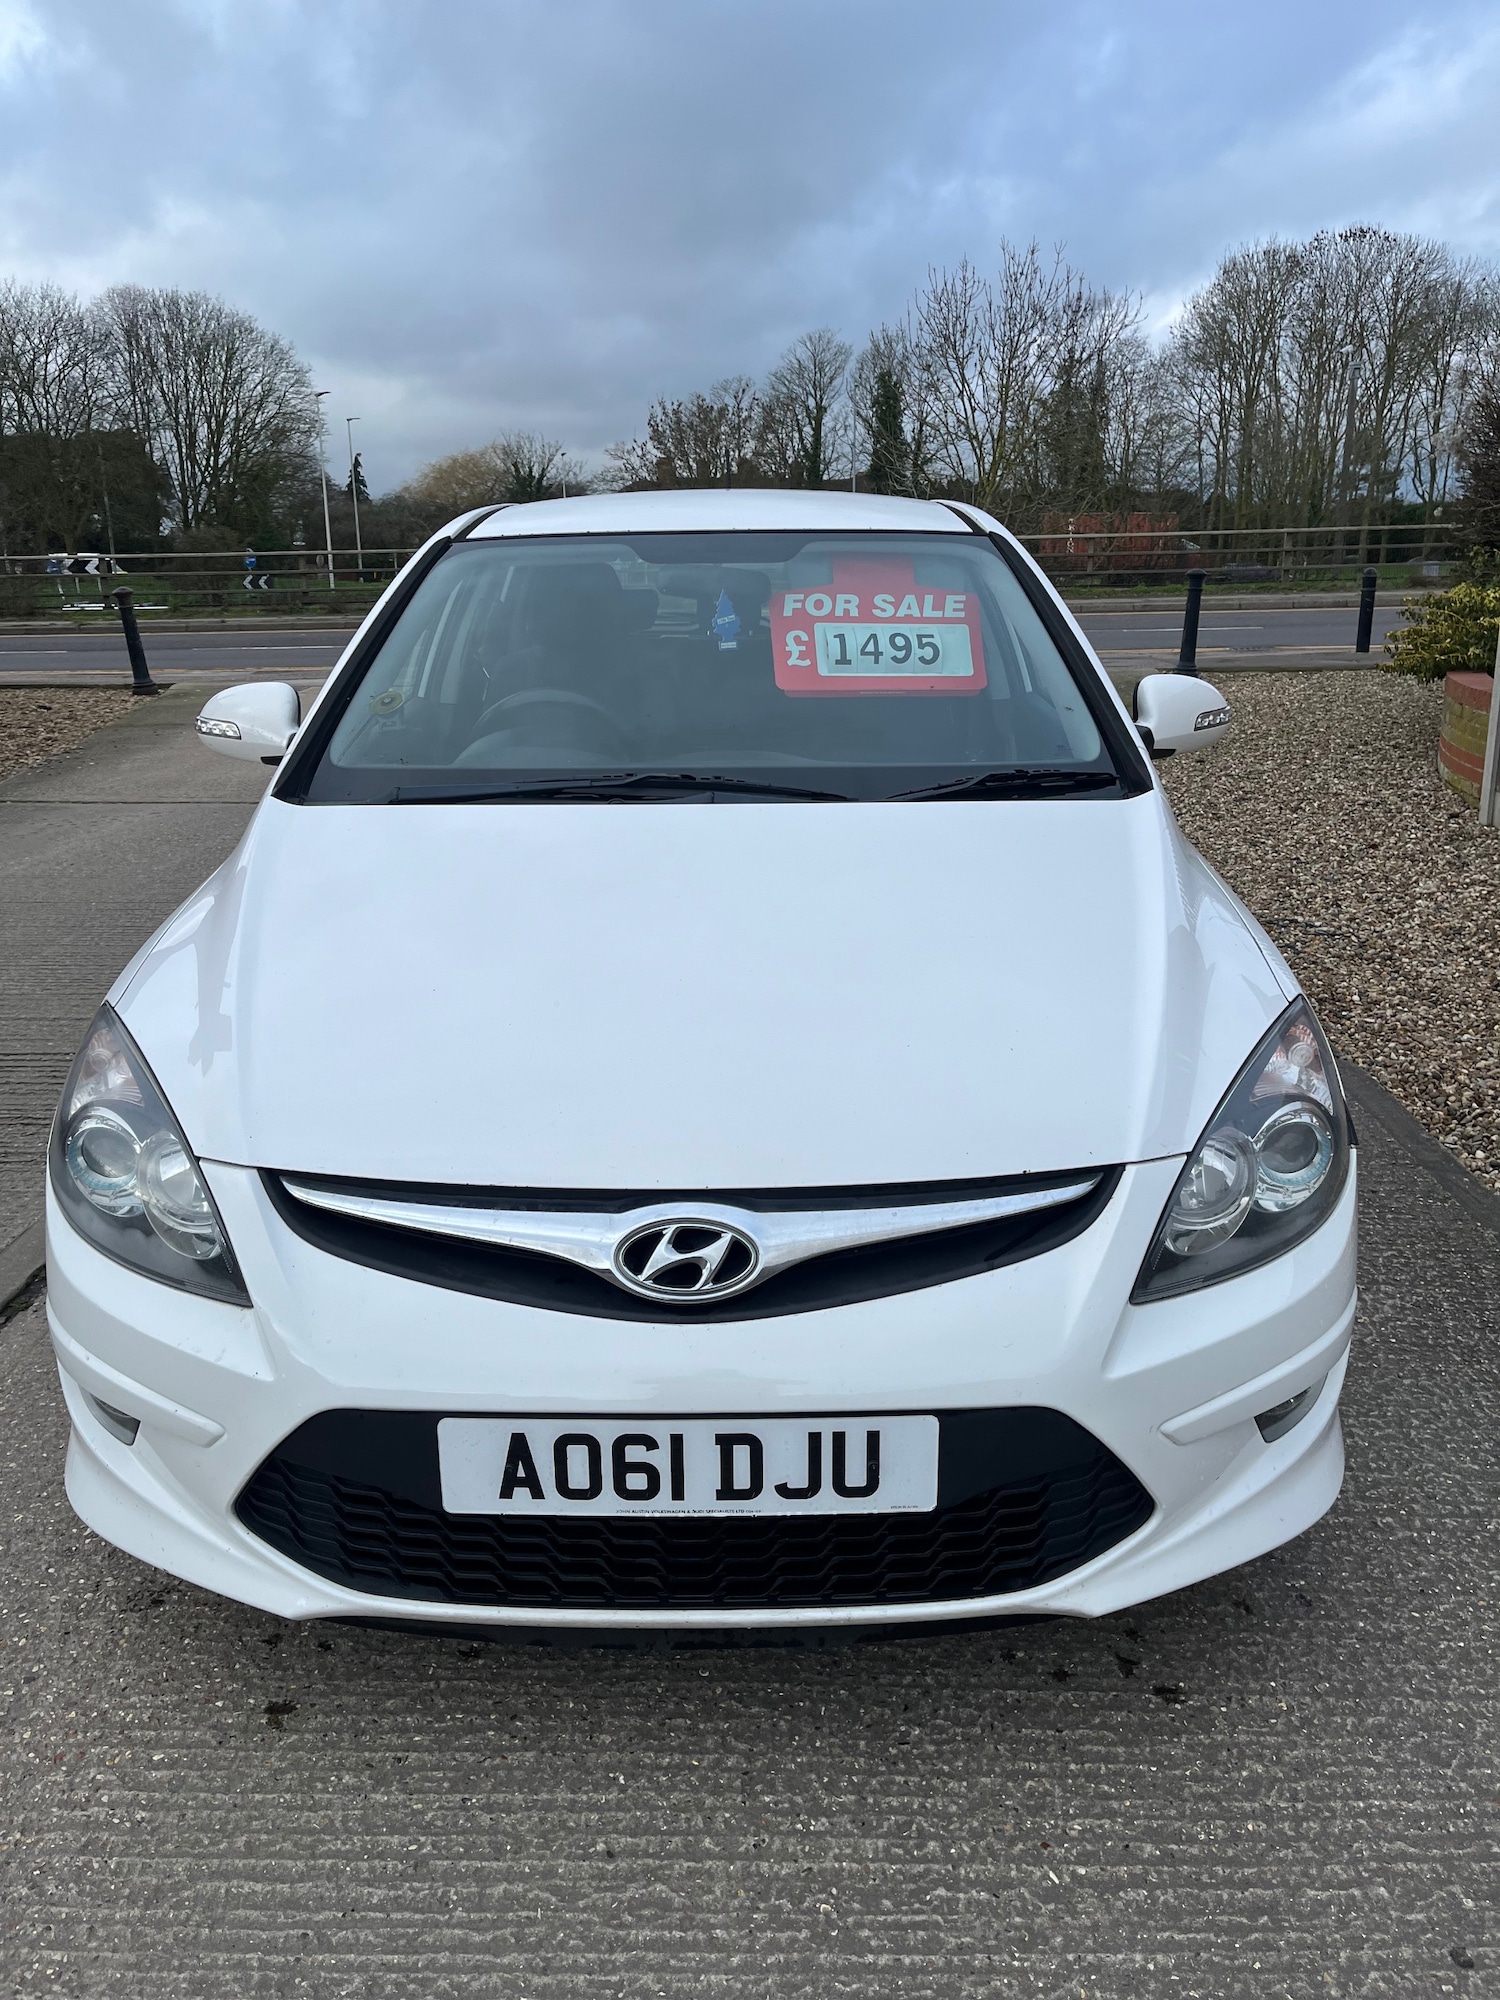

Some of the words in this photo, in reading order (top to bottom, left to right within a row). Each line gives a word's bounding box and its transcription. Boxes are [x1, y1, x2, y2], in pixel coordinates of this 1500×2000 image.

[783, 593, 860, 617] FOR
[871, 593, 967, 618] SALE
[785, 630, 812, 667] £
[833, 632, 941, 666] 1495
[498, 1432, 686, 1501] AO61
[714, 1429, 881, 1501] DJU
